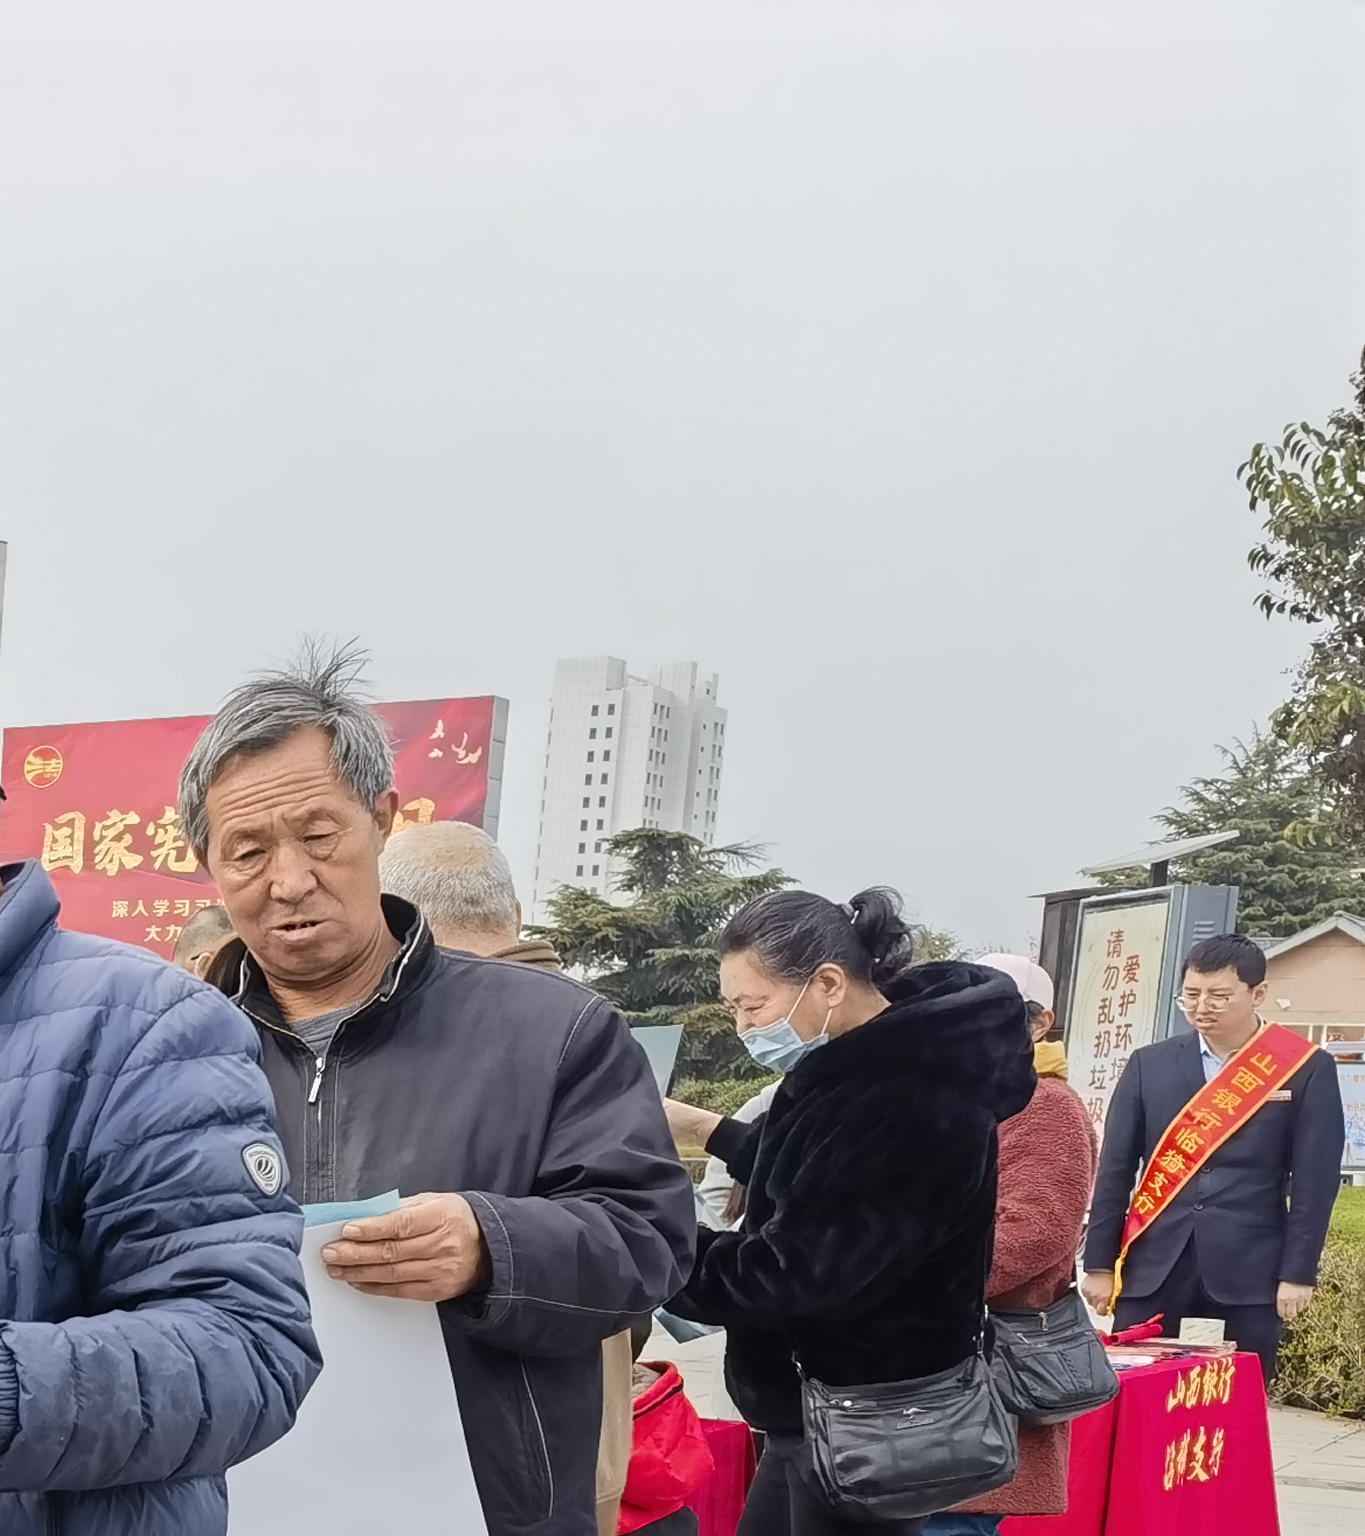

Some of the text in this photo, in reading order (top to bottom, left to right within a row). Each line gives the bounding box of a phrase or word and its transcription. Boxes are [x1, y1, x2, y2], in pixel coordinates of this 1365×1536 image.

[111, 898, 225, 918] 深入学习习
[1088, 930, 1124, 1124] 请勿乱扔垃圾
[1134, 1051, 1276, 1214] 山西银行临猗支行
